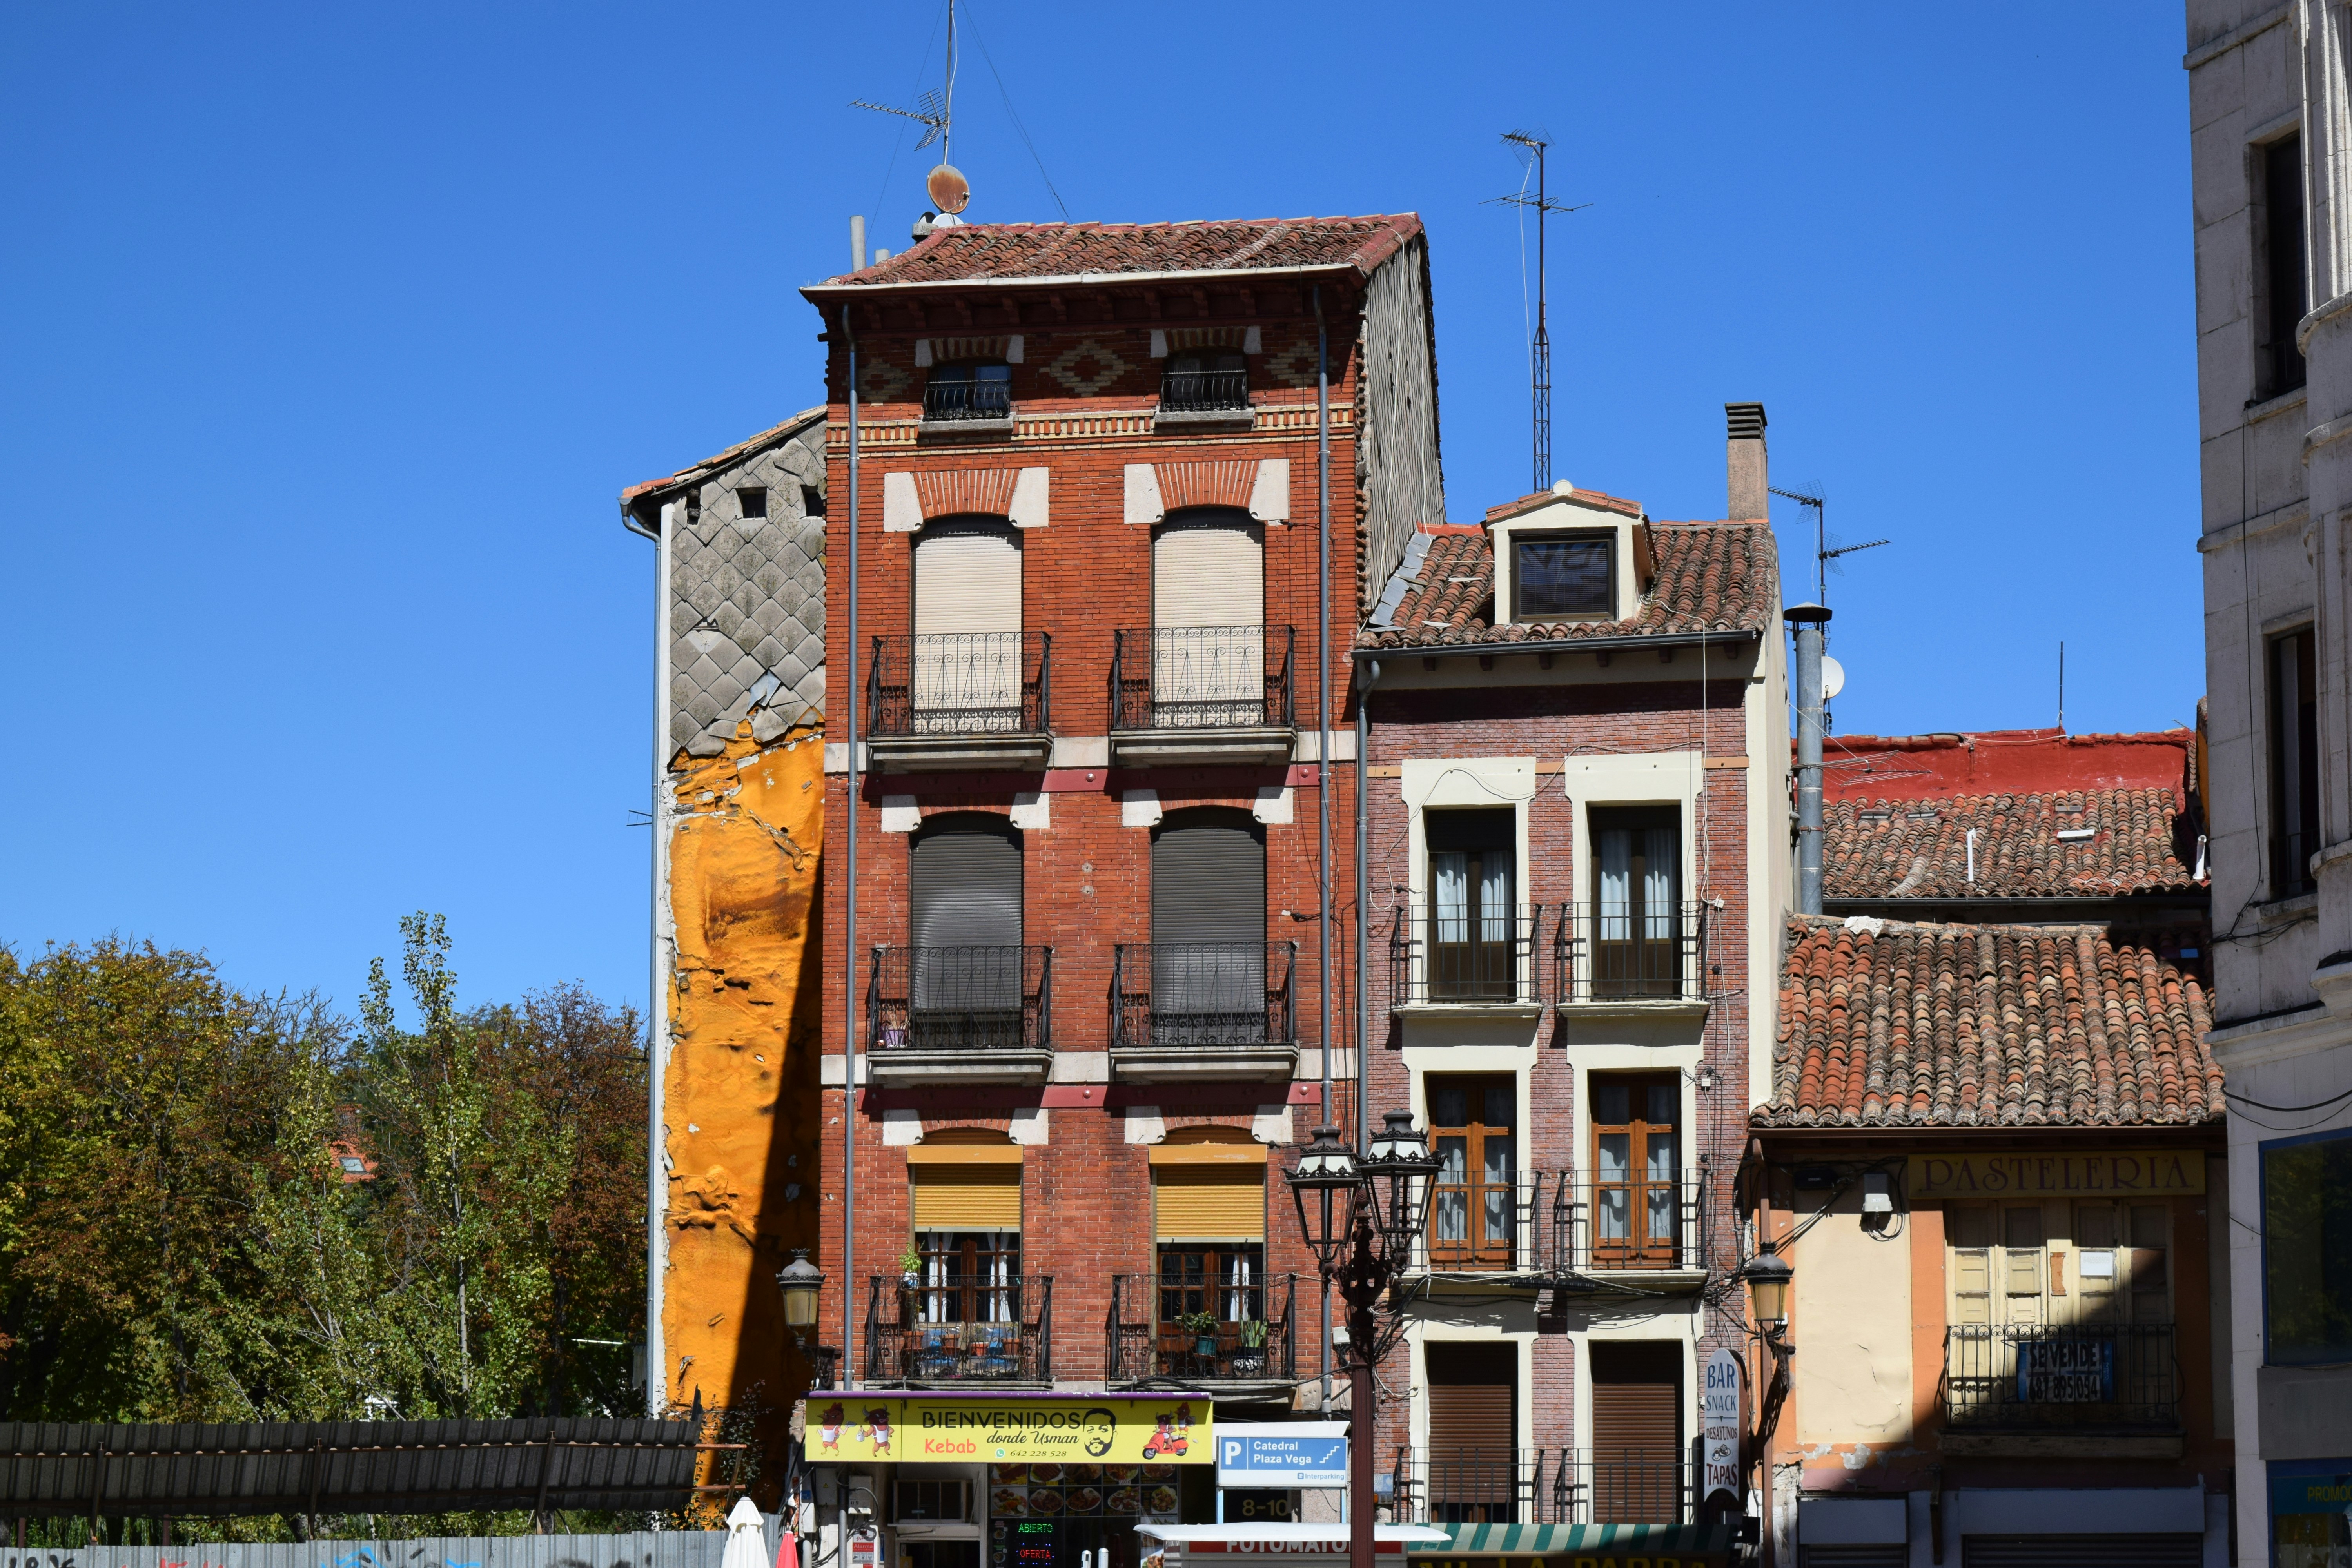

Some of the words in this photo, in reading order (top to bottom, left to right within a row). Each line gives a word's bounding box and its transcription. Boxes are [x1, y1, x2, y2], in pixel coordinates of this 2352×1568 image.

[1922, 1156, 2194, 1192] PASTELERIA
[2030, 1344, 2045, 1368] SE
[2049, 1343, 2096, 1367] VENDE
[1708, 1362, 1735, 1388] BAR
[1706, 1394, 1737, 1412] SNACK
[923, 1412, 1080, 1429] BIENVENIDOS
[987, 1430, 1027, 1444] donde
[1030, 1430, 1080, 1444] Usman
[1706, 1426, 1737, 1441] DESAYUNOS
[925, 1438, 976, 1454] Kebab
[1225, 1441, 1241, 1465] P
[1254, 1441, 1298, 1451] Catedral
[1254, 1454, 1282, 1464] Plaza
[1285, 1454, 1312, 1465] Vega
[1305, 1472, 1345, 1481] Interparking
[1706, 1463, 1737, 1487] TAPAS
[1242, 1499, 1287, 1516] 8-10
[1018, 1523, 1053, 1533] ABIERTO
[1020, 1549, 1051, 1559] OFERTA
